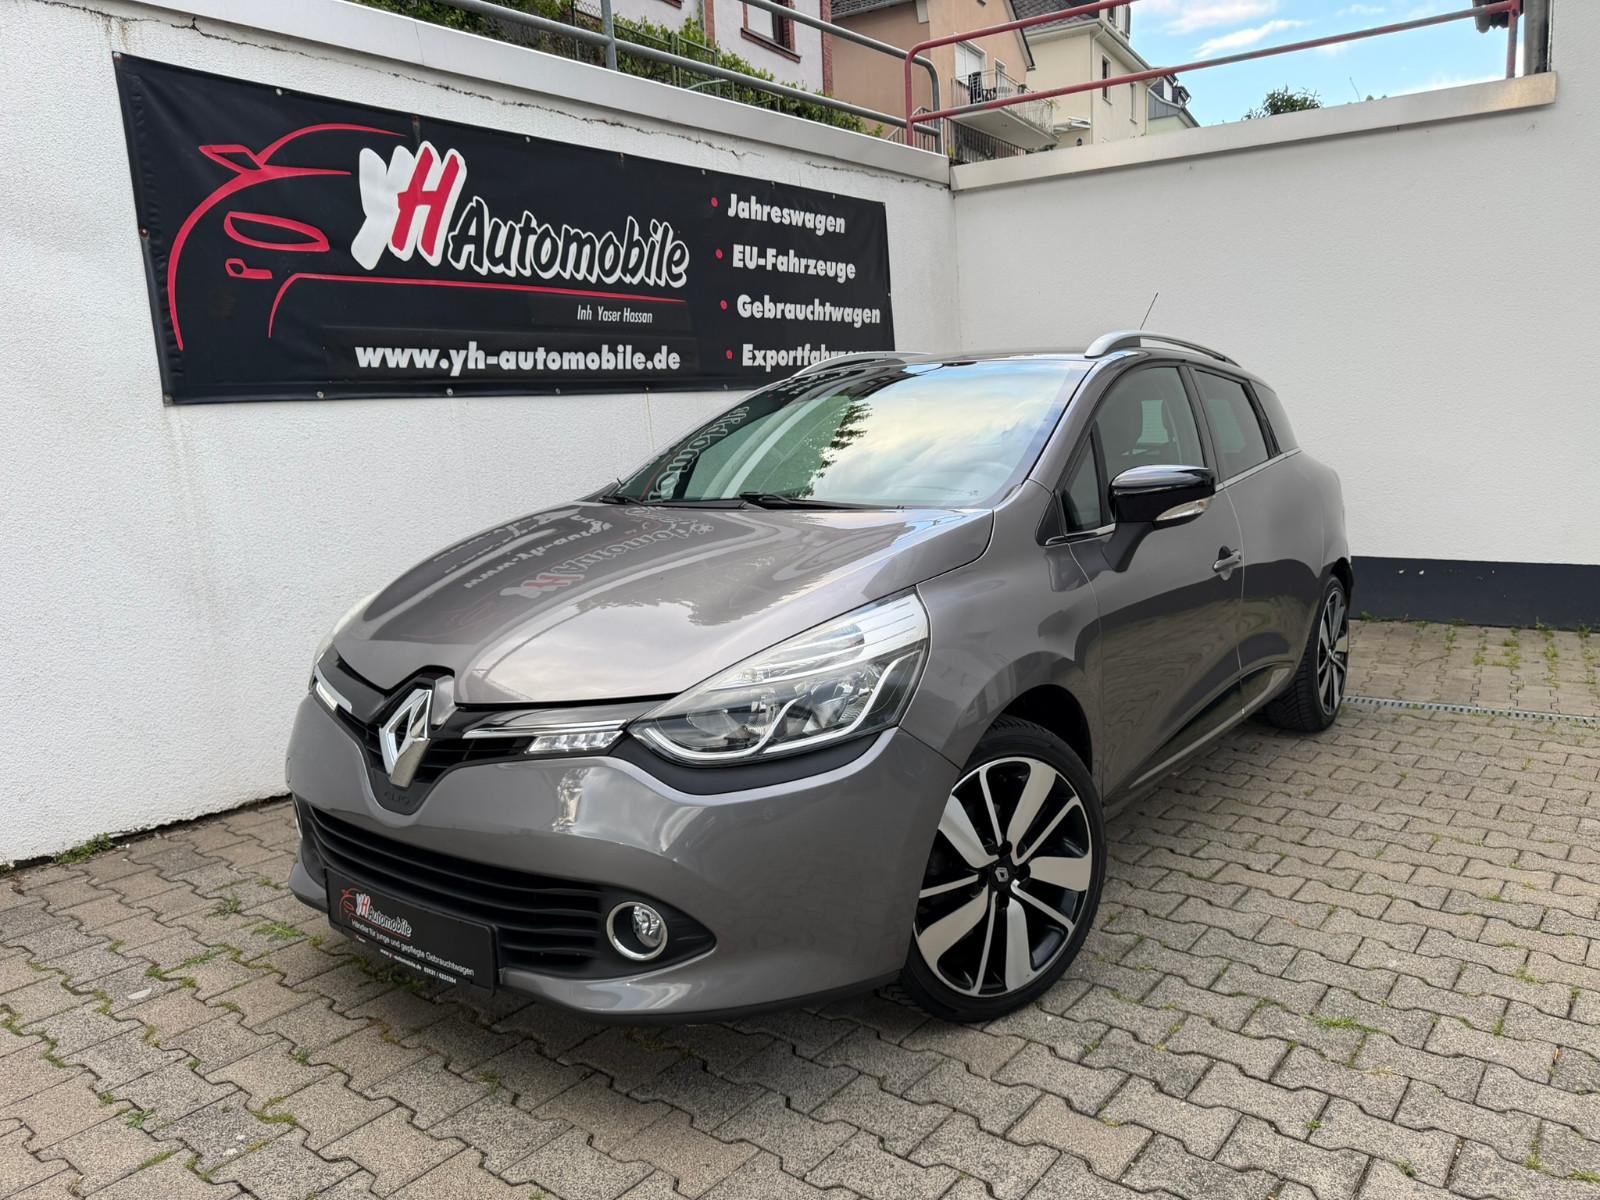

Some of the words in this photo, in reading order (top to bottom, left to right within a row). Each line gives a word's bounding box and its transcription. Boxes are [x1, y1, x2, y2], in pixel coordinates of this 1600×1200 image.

[728, 193, 845, 235] Jahreswagen
[448, 195, 690, 288] Automobile
[732, 244, 856, 283] EU-Fahrzeuge
[577, 304, 592, 321] Inh
[598, 306, 621, 322] Yaser
[623, 307, 653, 324] Hassan
[737, 294, 880, 327] Gebrauchtwagen
[354, 341, 681, 376] www.yh-automobile.de
[368, 906, 412, 937] Automobile
[425, 952, 475, 976] Gebrauchtwagen
